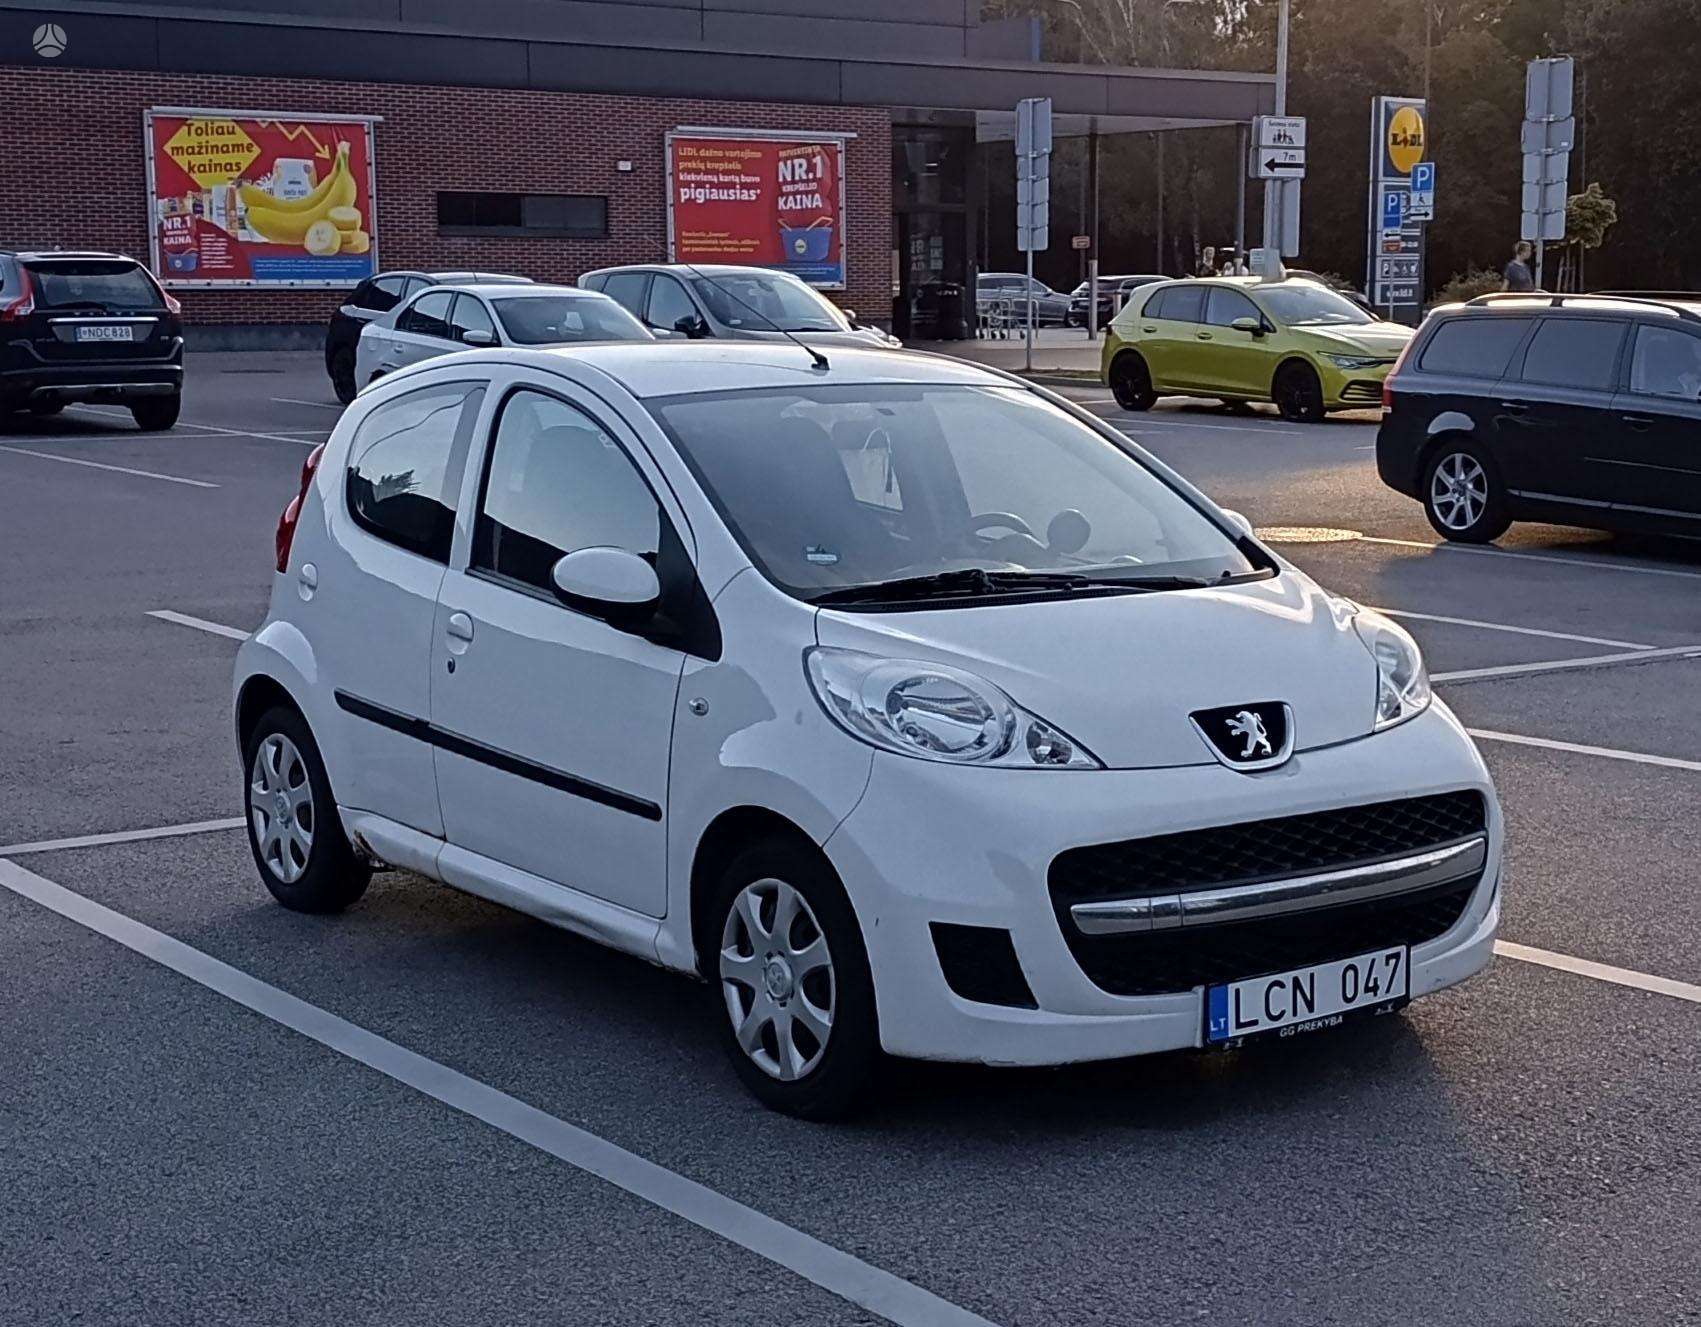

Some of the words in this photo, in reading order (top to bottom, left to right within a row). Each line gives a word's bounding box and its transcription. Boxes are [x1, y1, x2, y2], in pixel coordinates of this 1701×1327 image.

[186, 121, 236, 137] Toliau
[170, 140, 255, 156] mažiname
[187, 158, 242, 174] kainas
[778, 155, 823, 182] NR.1
[1417, 166, 1430, 189] P
[778, 193, 823, 211] KAINA
[1388, 194, 1398, 213] P
[163, 215, 191, 230] NR.1
[163, 235, 192, 245] KAINA
[1234, 971, 1316, 1031] LCN
[1341, 951, 1401, 1005] 047
[1209, 1017, 1227, 1033] LT
[1297, 1015, 1344, 1033] PREKYBA
